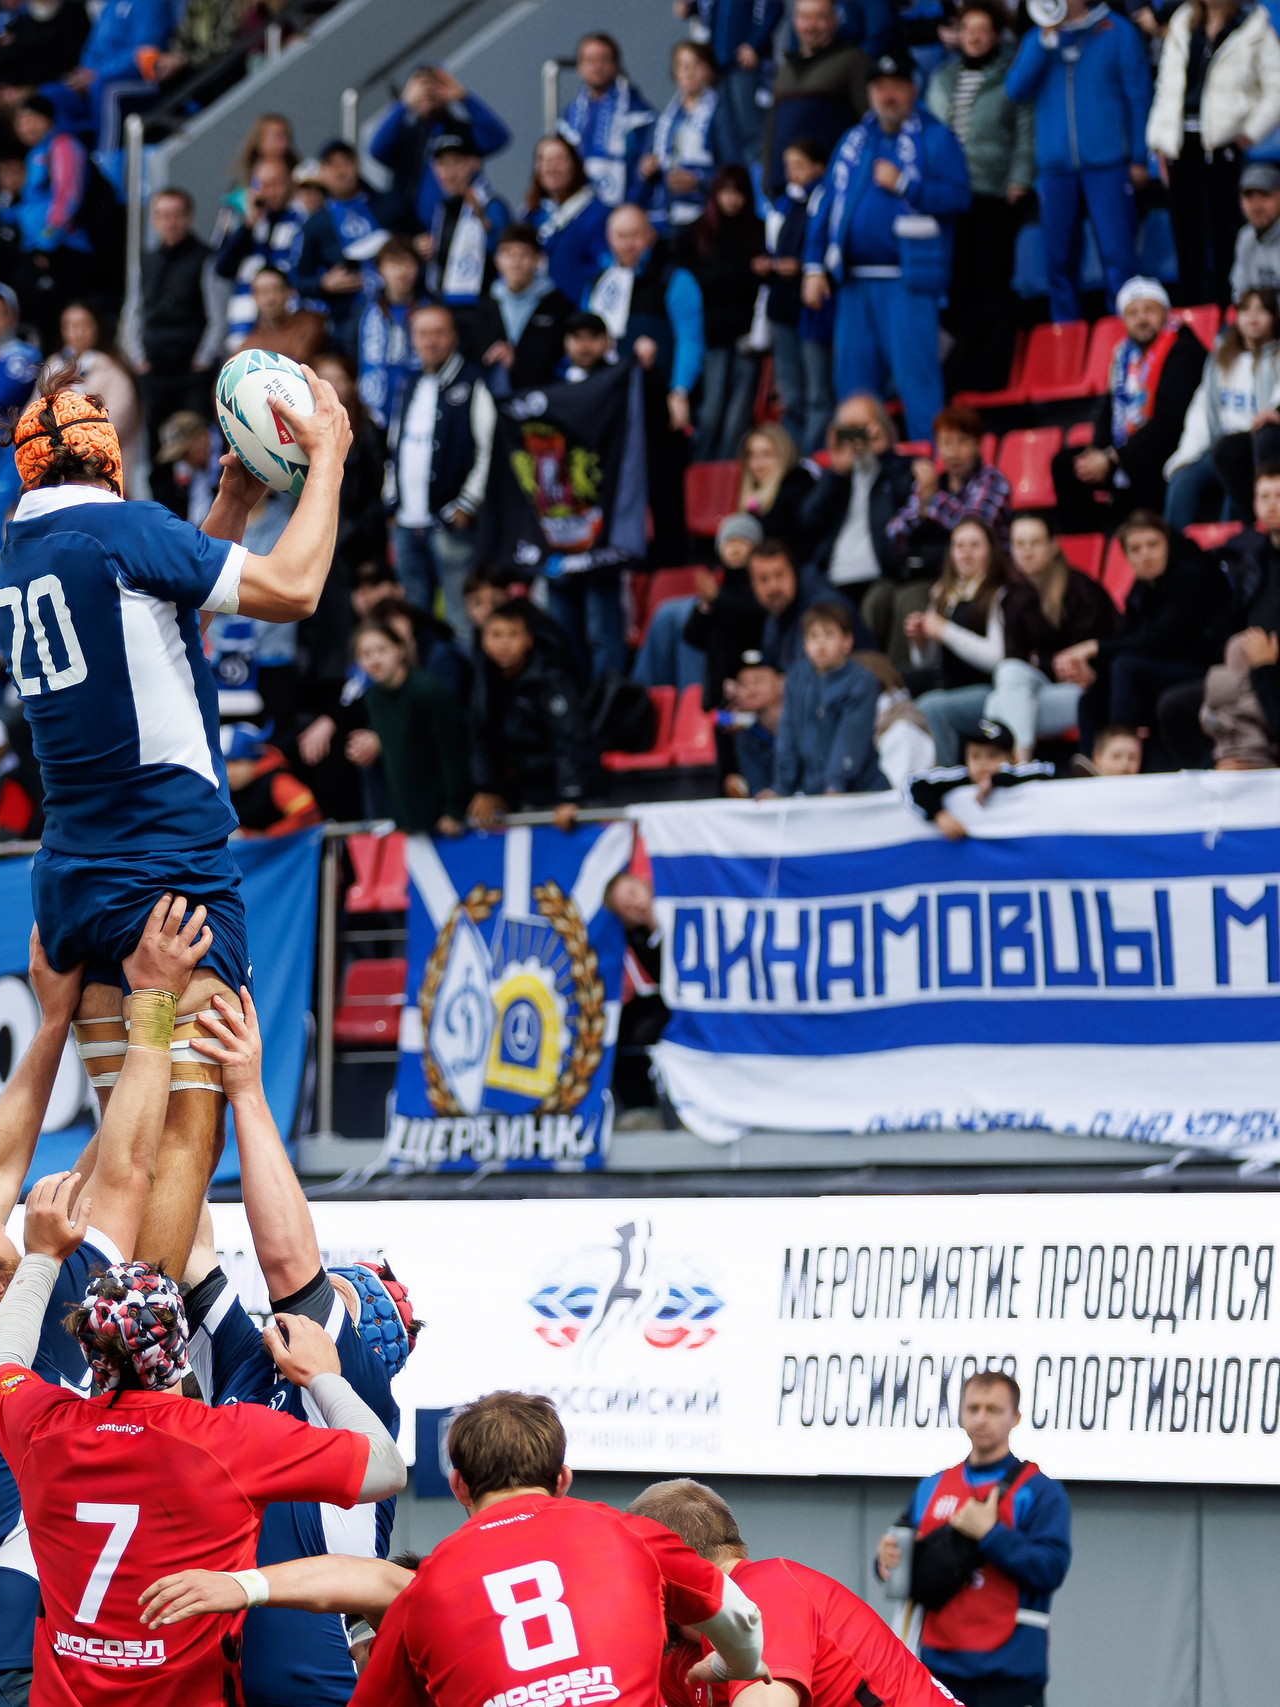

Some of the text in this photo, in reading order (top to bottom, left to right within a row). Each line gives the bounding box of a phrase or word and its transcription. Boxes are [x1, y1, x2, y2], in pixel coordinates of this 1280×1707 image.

[271, 378, 296, 408] РЕГБИ
[673, 889, 1175, 1001] ДИНАМОВЦЫ
[780, 1245, 1274, 1334] МЕРОПРИЯТИЕ ПРОВОДИТСЯ
[528, 1376, 720, 1416] ОССИЙСКИЙ
[778, 1339, 1280, 1434] РОССИЙСК СПОРТИВНОГО
[74, 1502, 140, 1624] 7
[482, 1560, 580, 1672] 8
